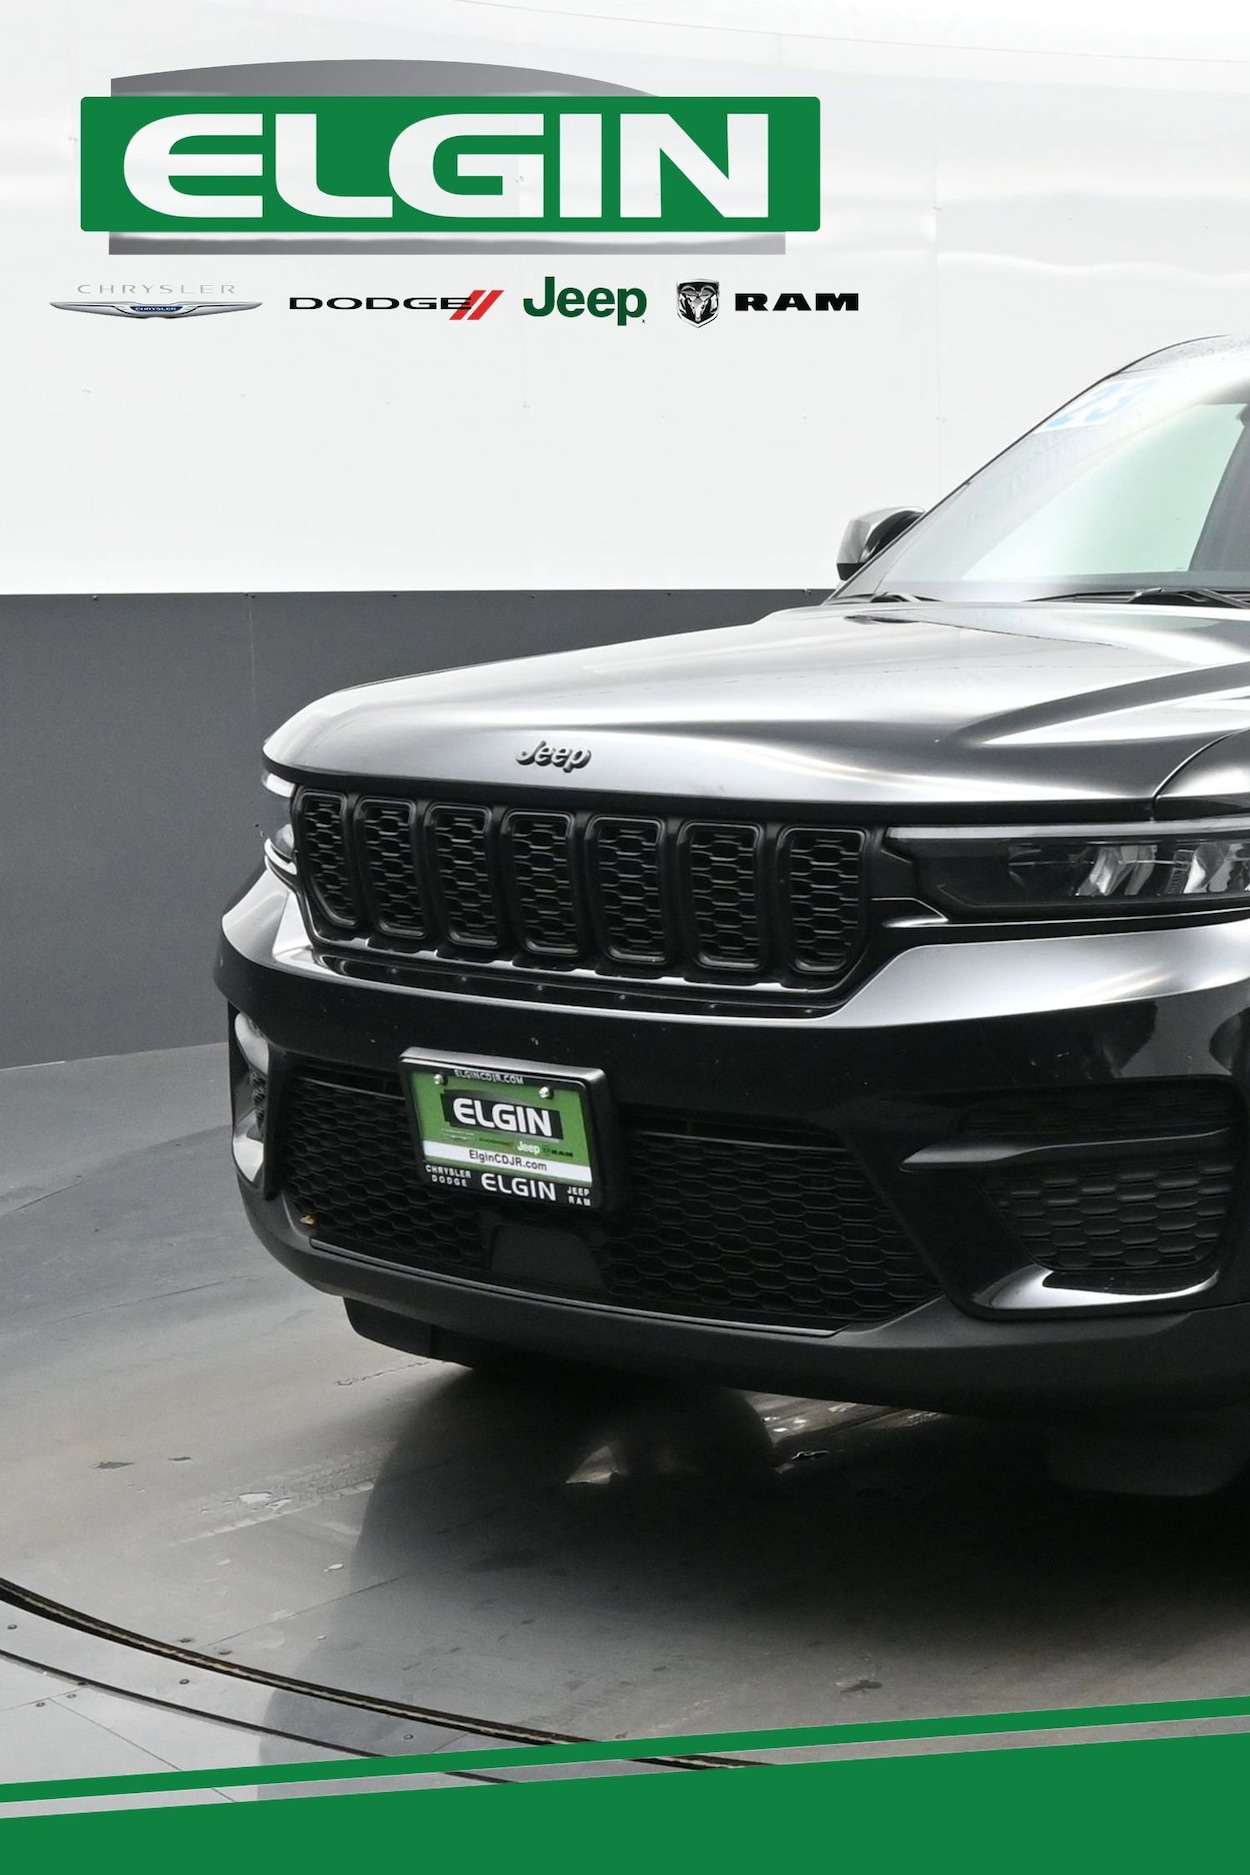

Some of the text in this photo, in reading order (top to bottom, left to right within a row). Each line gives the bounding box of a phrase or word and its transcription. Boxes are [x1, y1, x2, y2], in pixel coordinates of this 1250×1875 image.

[515, 739, 592, 774] Jeep
[454, 1069, 525, 1085] ELGINCDJR.COM
[453, 1098, 552, 1137] ELGIN
[517, 1141, 541, 1156] Jeep
[469, 1149, 548, 1171] ElginCDJR.com
[426, 1164, 472, 1179] CHRYSLER
[432, 1174, 468, 1188] DODGE
[481, 1173, 556, 1201] ELGIN
[567, 1186, 590, 1197] JEEP
[568, 1195, 592, 1207] RAM
